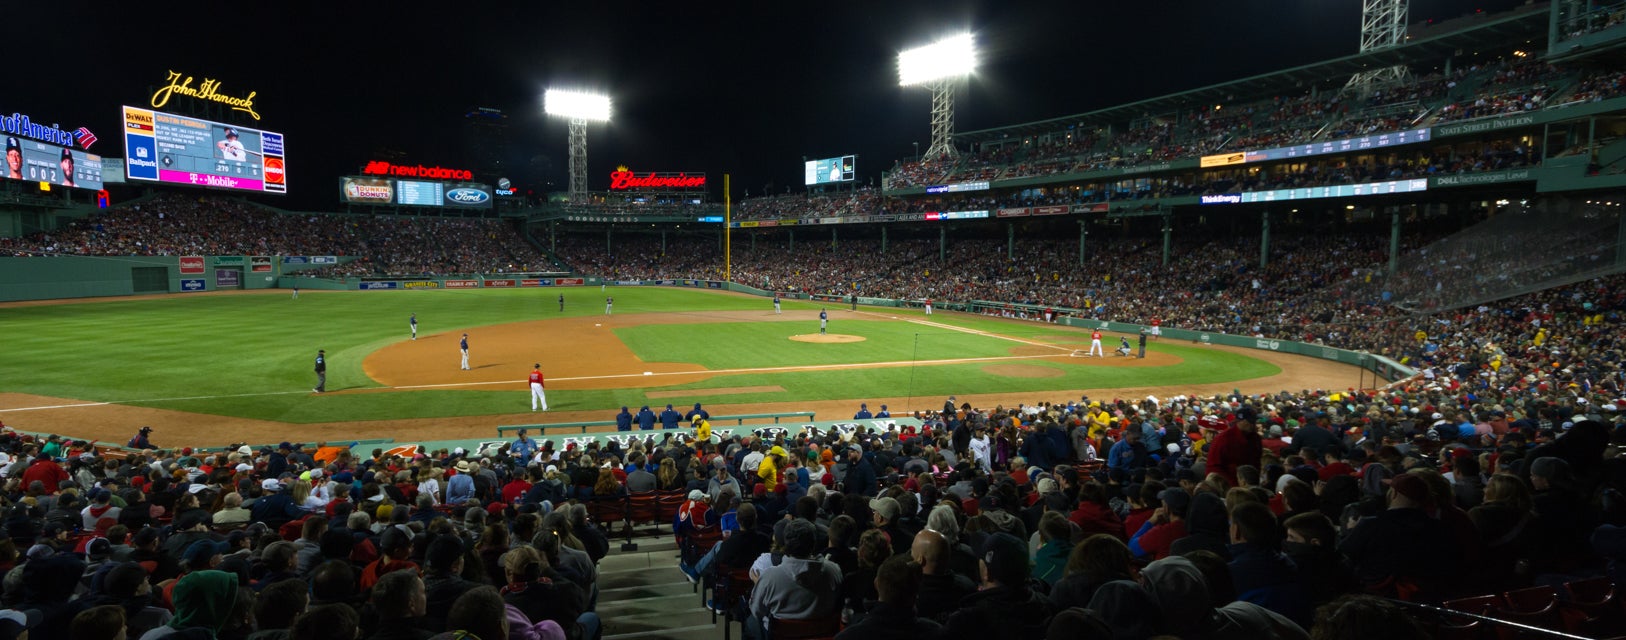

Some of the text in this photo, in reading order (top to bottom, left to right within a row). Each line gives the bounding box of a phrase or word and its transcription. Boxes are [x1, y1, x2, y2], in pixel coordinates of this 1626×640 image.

[151, 69, 260, 120] John Hancock
[5, 113, 21, 135] of
[21, 115, 73, 147] America
[1440, 115, 1533, 136] STATE STREET PAVILION
[129, 158, 156, 167] Ballpark
[30, 167, 56, 182] 0 0 2
[390, 165, 418, 177] new
[418, 164, 473, 180] balance
[609, 170, 706, 189] Budweiser
[1437, 170, 1528, 185] DELL Technologies Level
[455, 190, 481, 202] Ford
